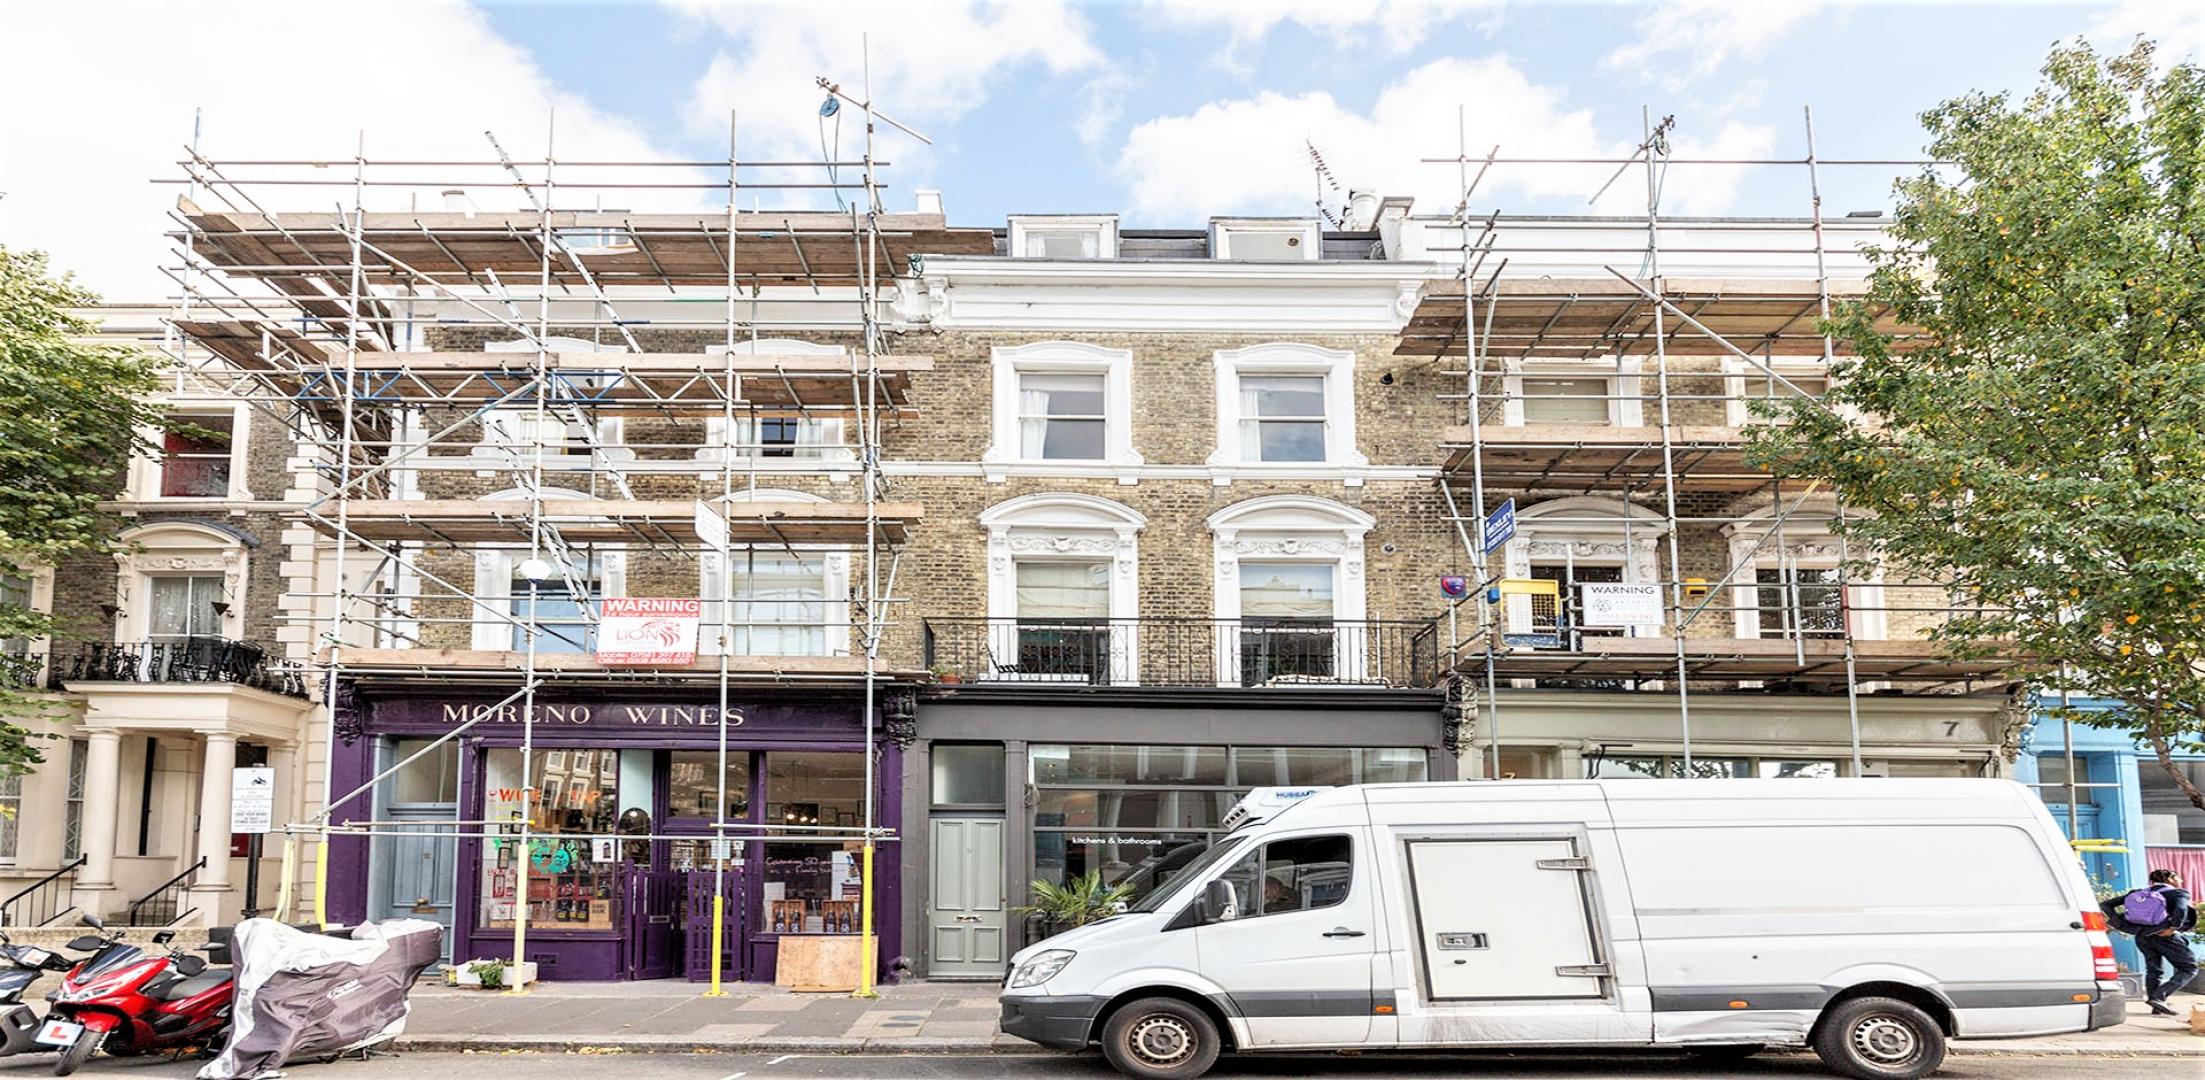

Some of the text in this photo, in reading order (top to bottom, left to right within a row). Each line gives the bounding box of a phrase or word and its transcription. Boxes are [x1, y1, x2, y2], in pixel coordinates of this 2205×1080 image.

[1591, 586, 1655, 594] WARNING
[607, 600, 699, 611] WARNING
[442, 705, 745, 726] MORENO WINES
[1942, 720, 1960, 737] 7
[1072, 836, 1106, 844] kitchens
[1117, 836, 1162, 845] bathrooms
[50, 1026, 67, 1039] L
